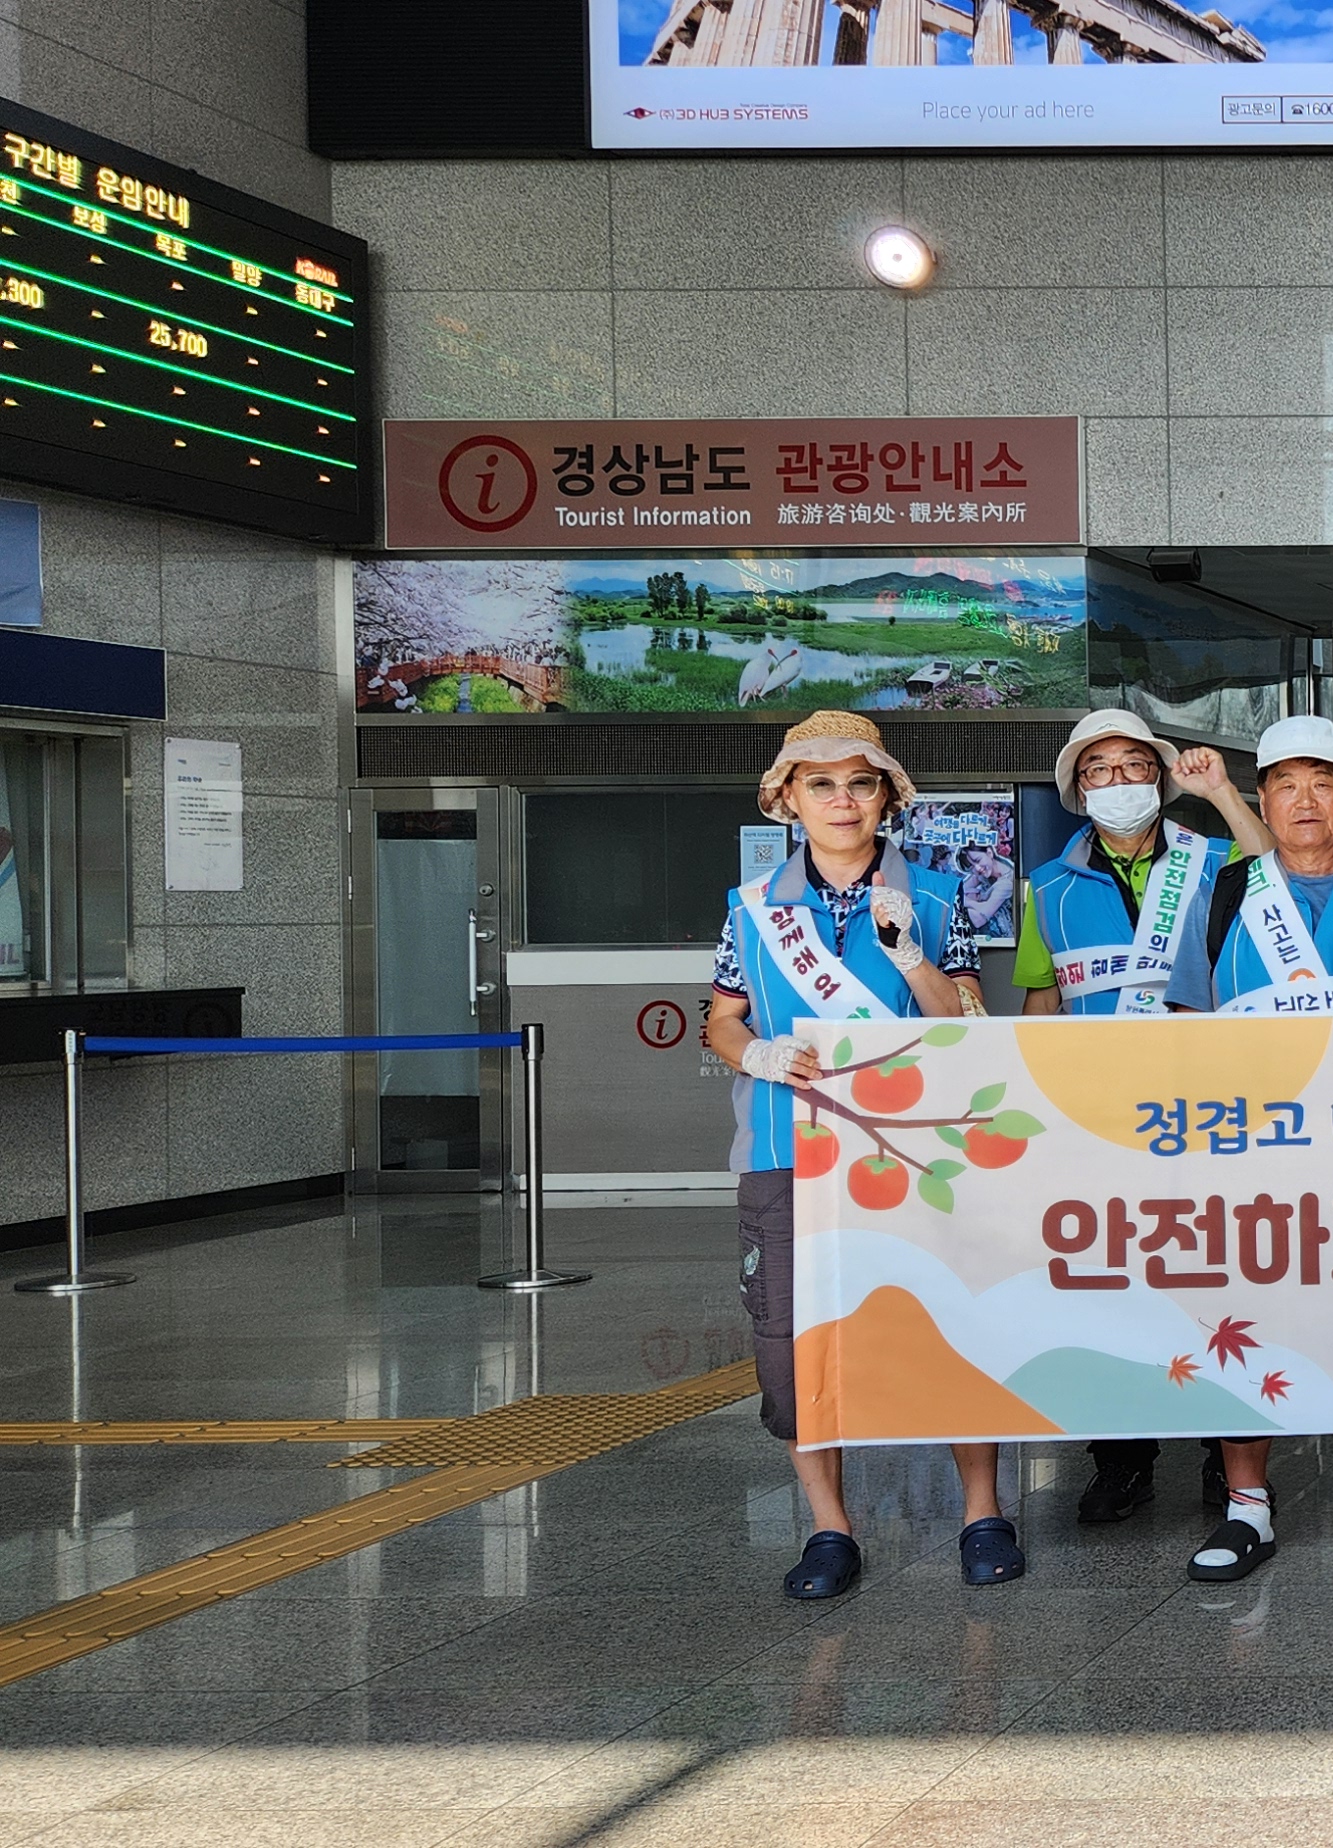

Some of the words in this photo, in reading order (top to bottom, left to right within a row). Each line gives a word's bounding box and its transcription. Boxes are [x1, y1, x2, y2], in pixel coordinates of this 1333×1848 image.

[676, 109, 696, 120] 3D
[733, 109, 808, 120] SYSTEMS
[922, 101, 971, 119] Place
[977, 104, 1018, 122] your
[1024, 101, 1046, 118] ad
[1052, 101, 1095, 118] here
[1227, 103, 1276, 117] 광고문의
[4, 132, 84, 190] 구간별
[96, 166, 191, 229] 운임안내
[72, 206, 108, 235] 보성
[155, 233, 189, 262] 목포
[295, 282, 337, 313] 동대구
[294, 257, 340, 288] KORAIL
[148, 319, 208, 358] 25,700
[552, 443, 751, 497] 경상남도
[775, 442, 1027, 494] 관광안내소
[555, 506, 624, 526] Tourist
[633, 505, 751, 525] Information
[1134, 1098, 1312, 1157] 정겹고
